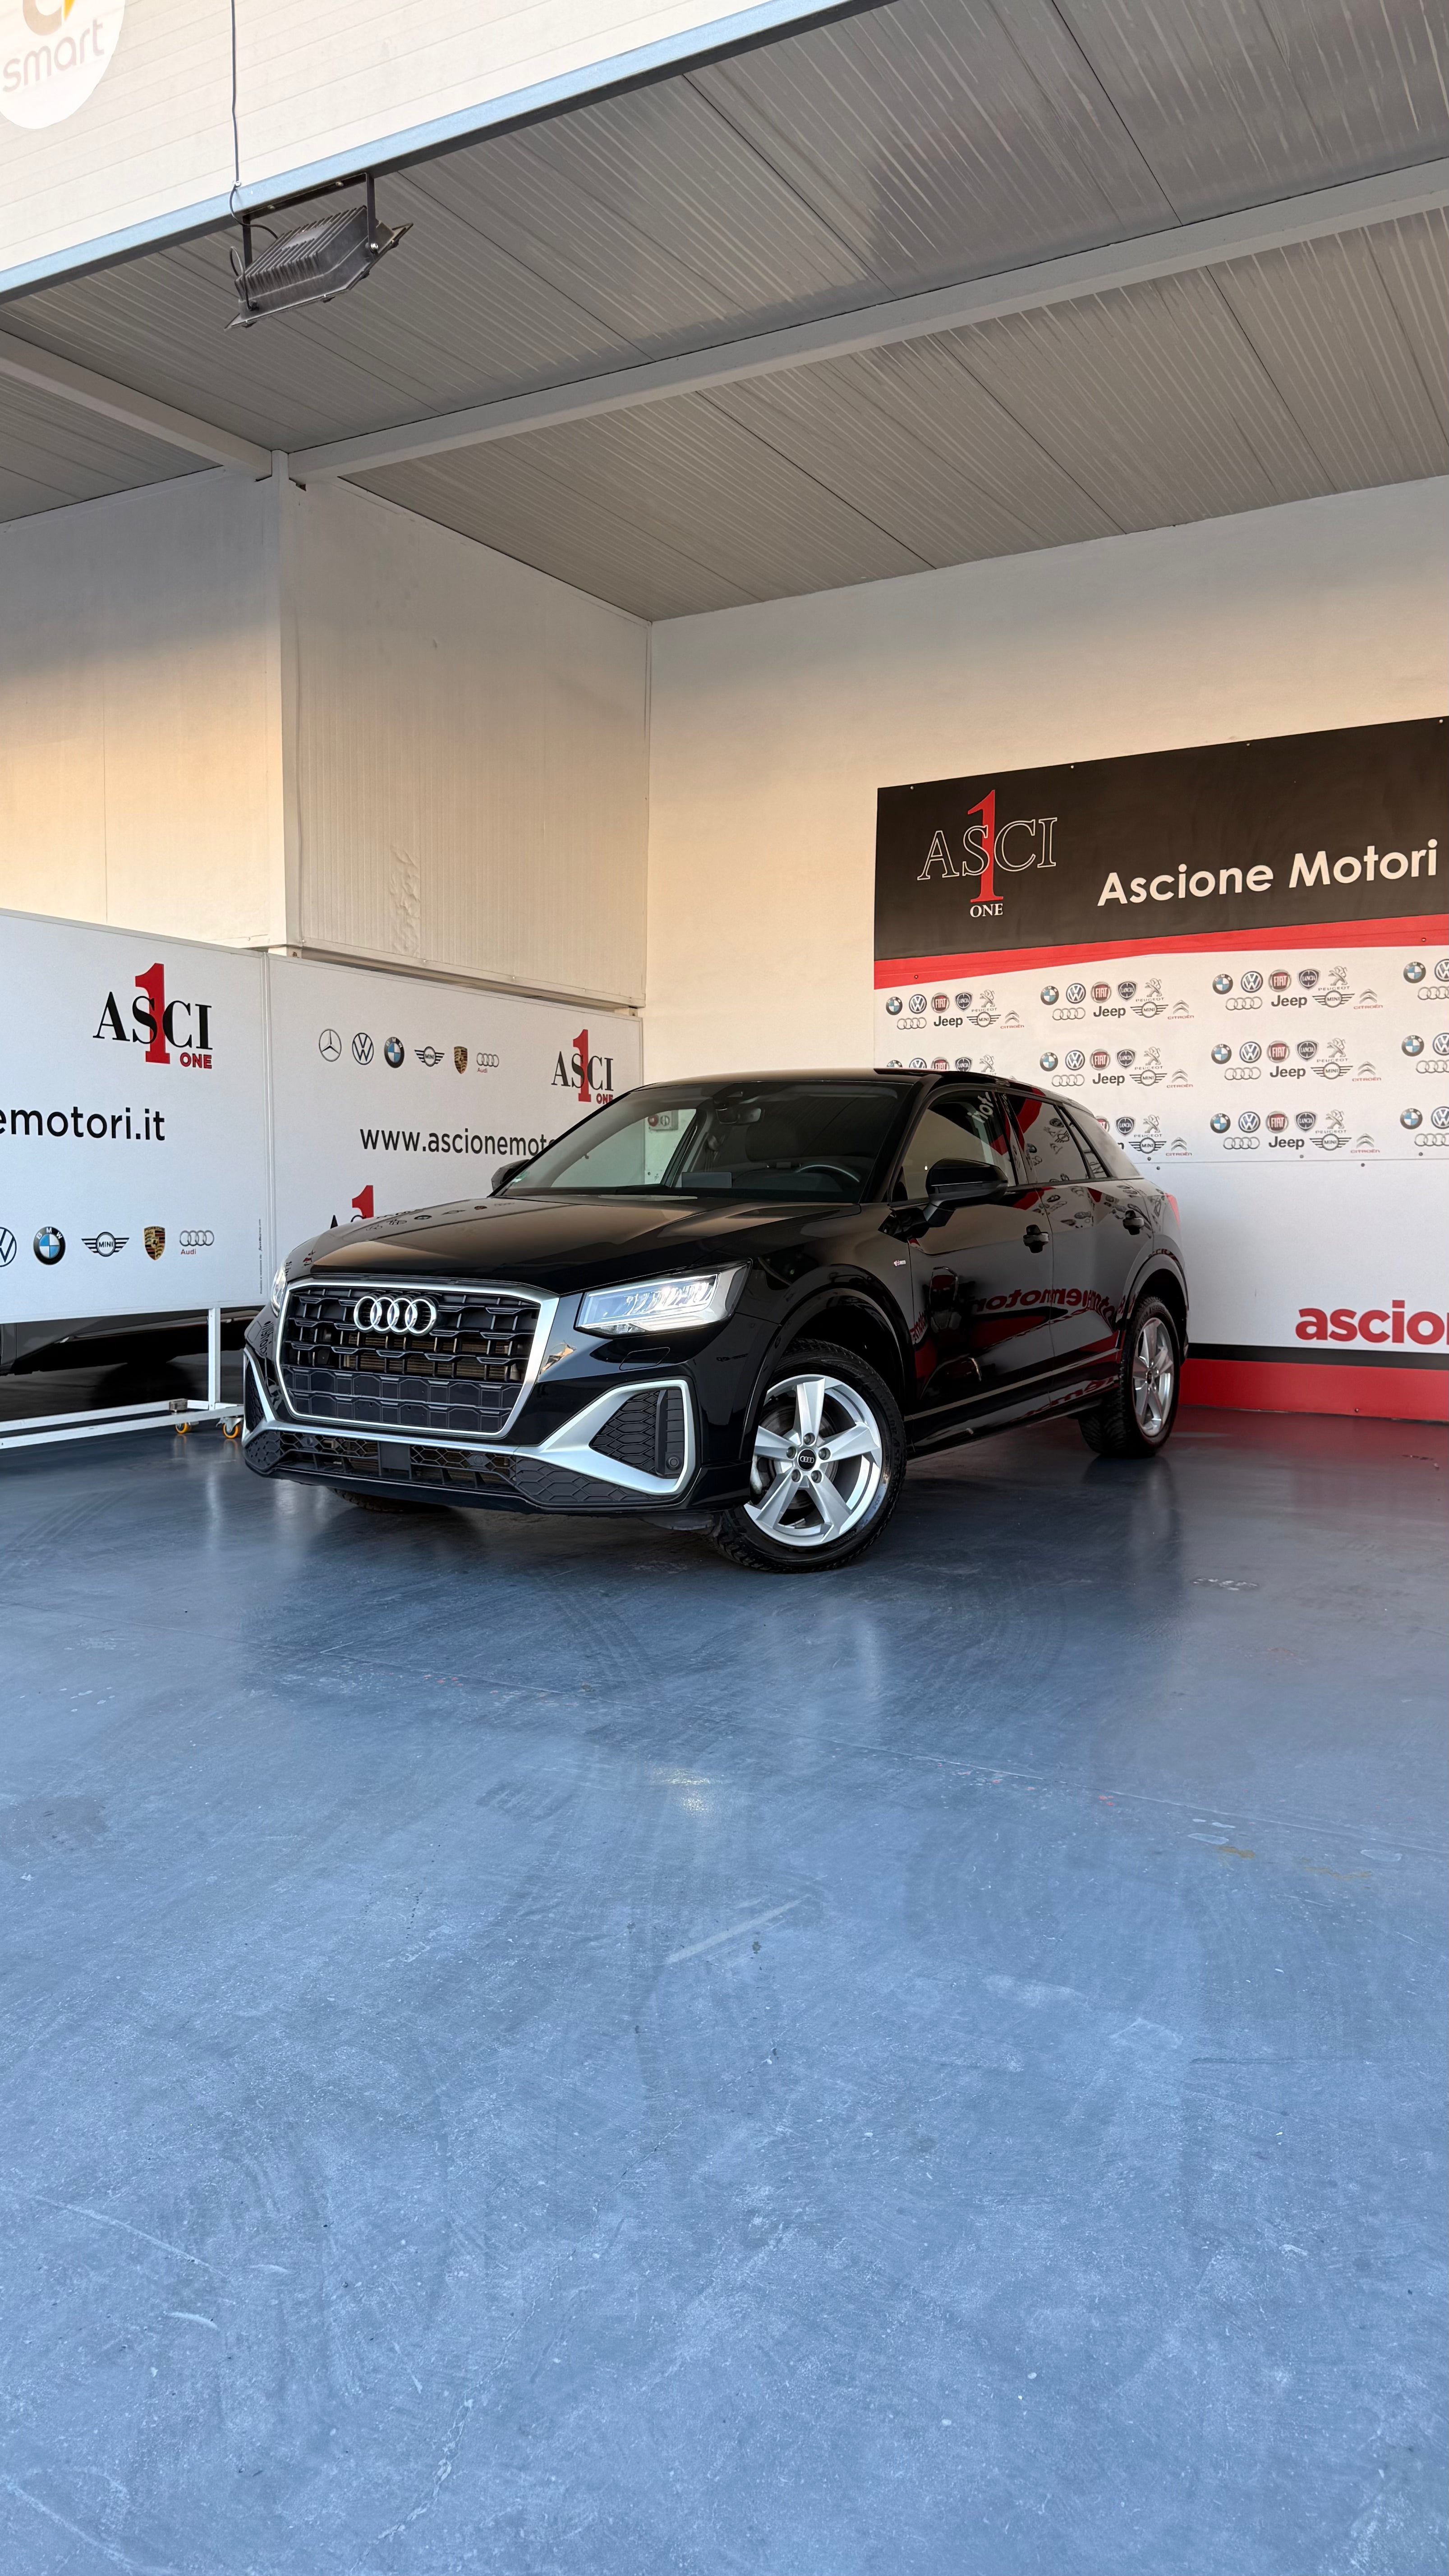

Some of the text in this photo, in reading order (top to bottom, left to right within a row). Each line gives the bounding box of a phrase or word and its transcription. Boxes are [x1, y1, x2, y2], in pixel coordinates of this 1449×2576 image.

[3, 18, 104, 92] smart
[1097, 839, 1438, 906] Ascione Motori
[970, 904, 1003, 917] ONE
[1274, 975, 1287, 986] FIAT
[1095, 988, 1108, 998] FIAT
[935, 998, 946, 1008] FIAT
[1271, 995, 1307, 1008] Jeep
[1093, 1006, 1126, 1018] Jeep
[934, 1016, 963, 1027] Jeep
[1272, 1047, 1286, 1058] FIAT
[180, 1052, 212, 1069] ONE
[1094, 1055, 1106, 1065] FIAT
[935, 1063, 946, 1071] FIAT
[1270, 1066, 1306, 1079] Jeep
[1092, 1073, 1125, 1086] Jeep
[1271, 1117, 1284, 1127] FIAT
[1268, 1136, 1305, 1150] Jeep
[36, 1227, 64, 1240] BMW
[1295, 1300, 1449, 1345] ascio
